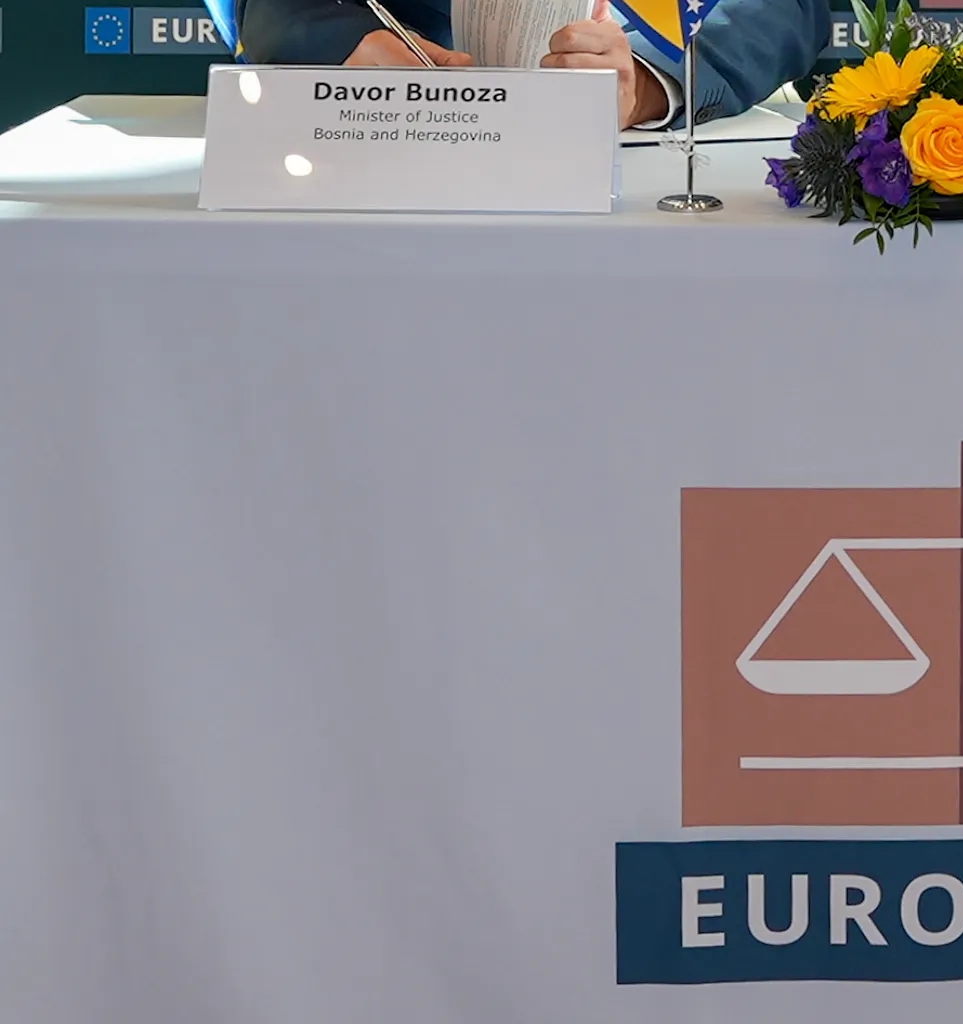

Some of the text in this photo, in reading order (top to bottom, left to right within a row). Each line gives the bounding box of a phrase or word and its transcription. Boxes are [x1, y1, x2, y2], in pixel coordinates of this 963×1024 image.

[314, 82, 507, 103] Davor Bunoza
[339, 109, 479, 124] Minister of Justice
[313, 127, 501, 145] Bosnia and Herzegovina
